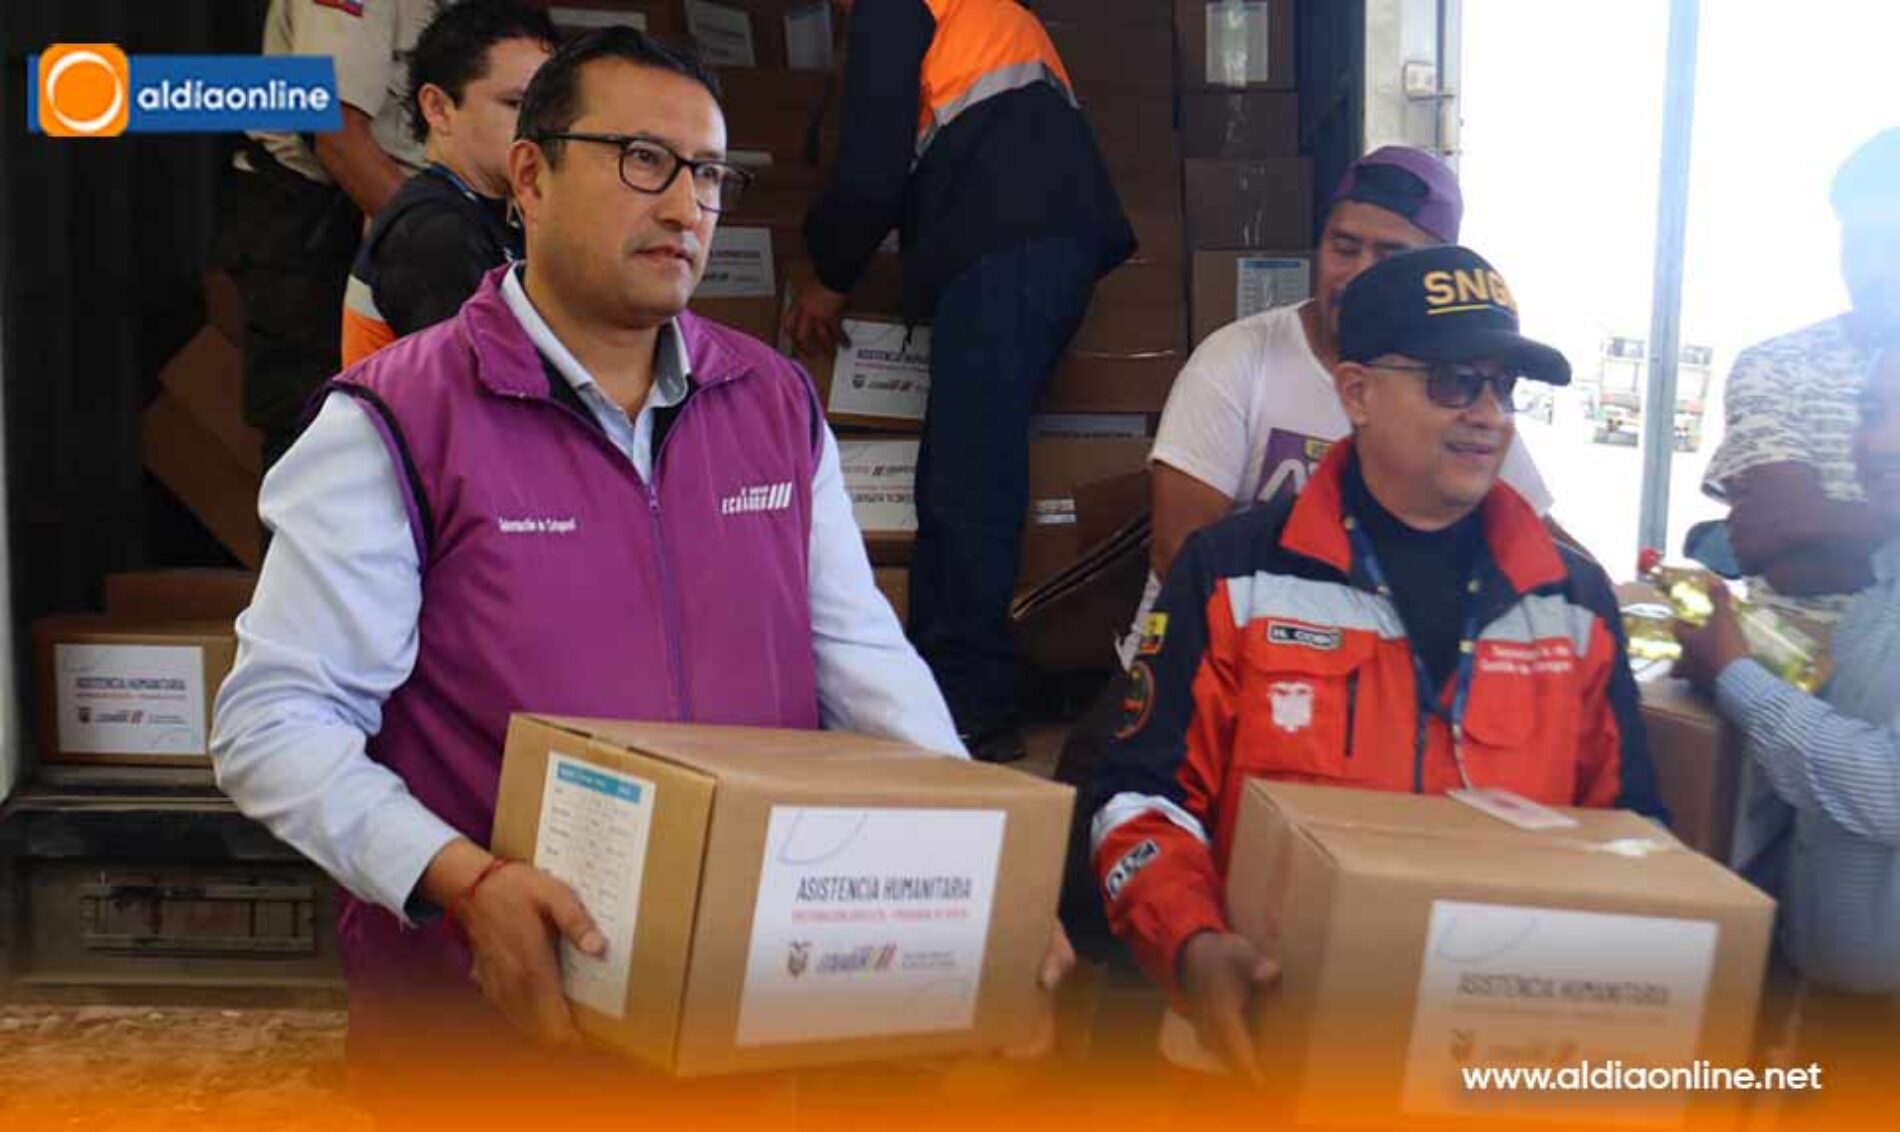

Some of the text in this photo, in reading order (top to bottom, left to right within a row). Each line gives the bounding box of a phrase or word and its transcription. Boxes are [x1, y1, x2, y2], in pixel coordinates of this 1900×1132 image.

[1424, 268, 1517, 310] SNG
[796, 875, 971, 902] ASISTENCIA HUMANITARIA
[1457, 972, 1670, 1006] ASISTENCIA HUMANITARIA
